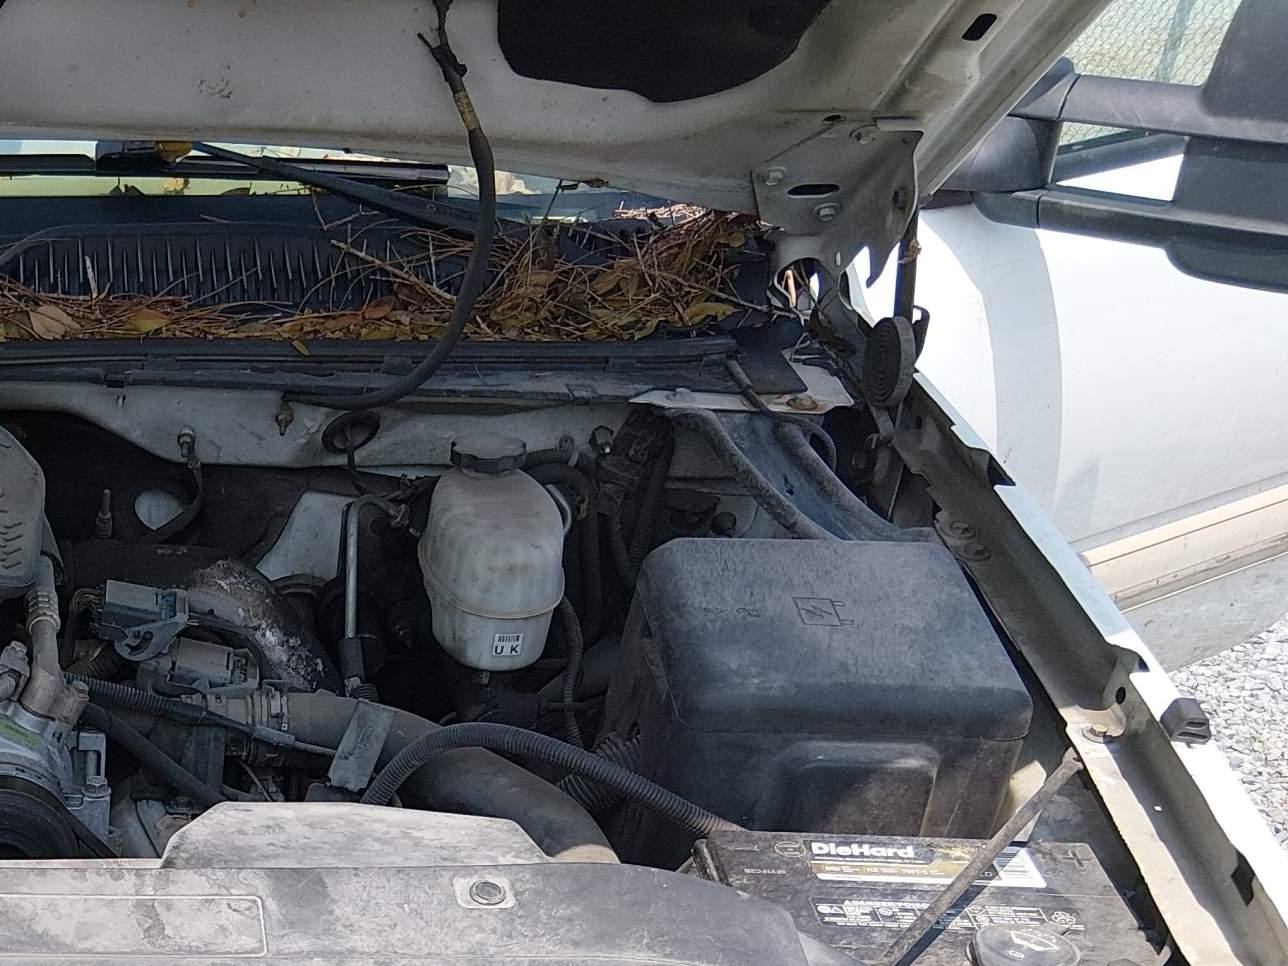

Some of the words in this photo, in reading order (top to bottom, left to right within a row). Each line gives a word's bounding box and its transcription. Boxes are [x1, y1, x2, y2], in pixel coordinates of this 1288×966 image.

[495, 645, 504, 655] U
[510, 644, 520, 654] K
[811, 842, 915, 858] DieHard
